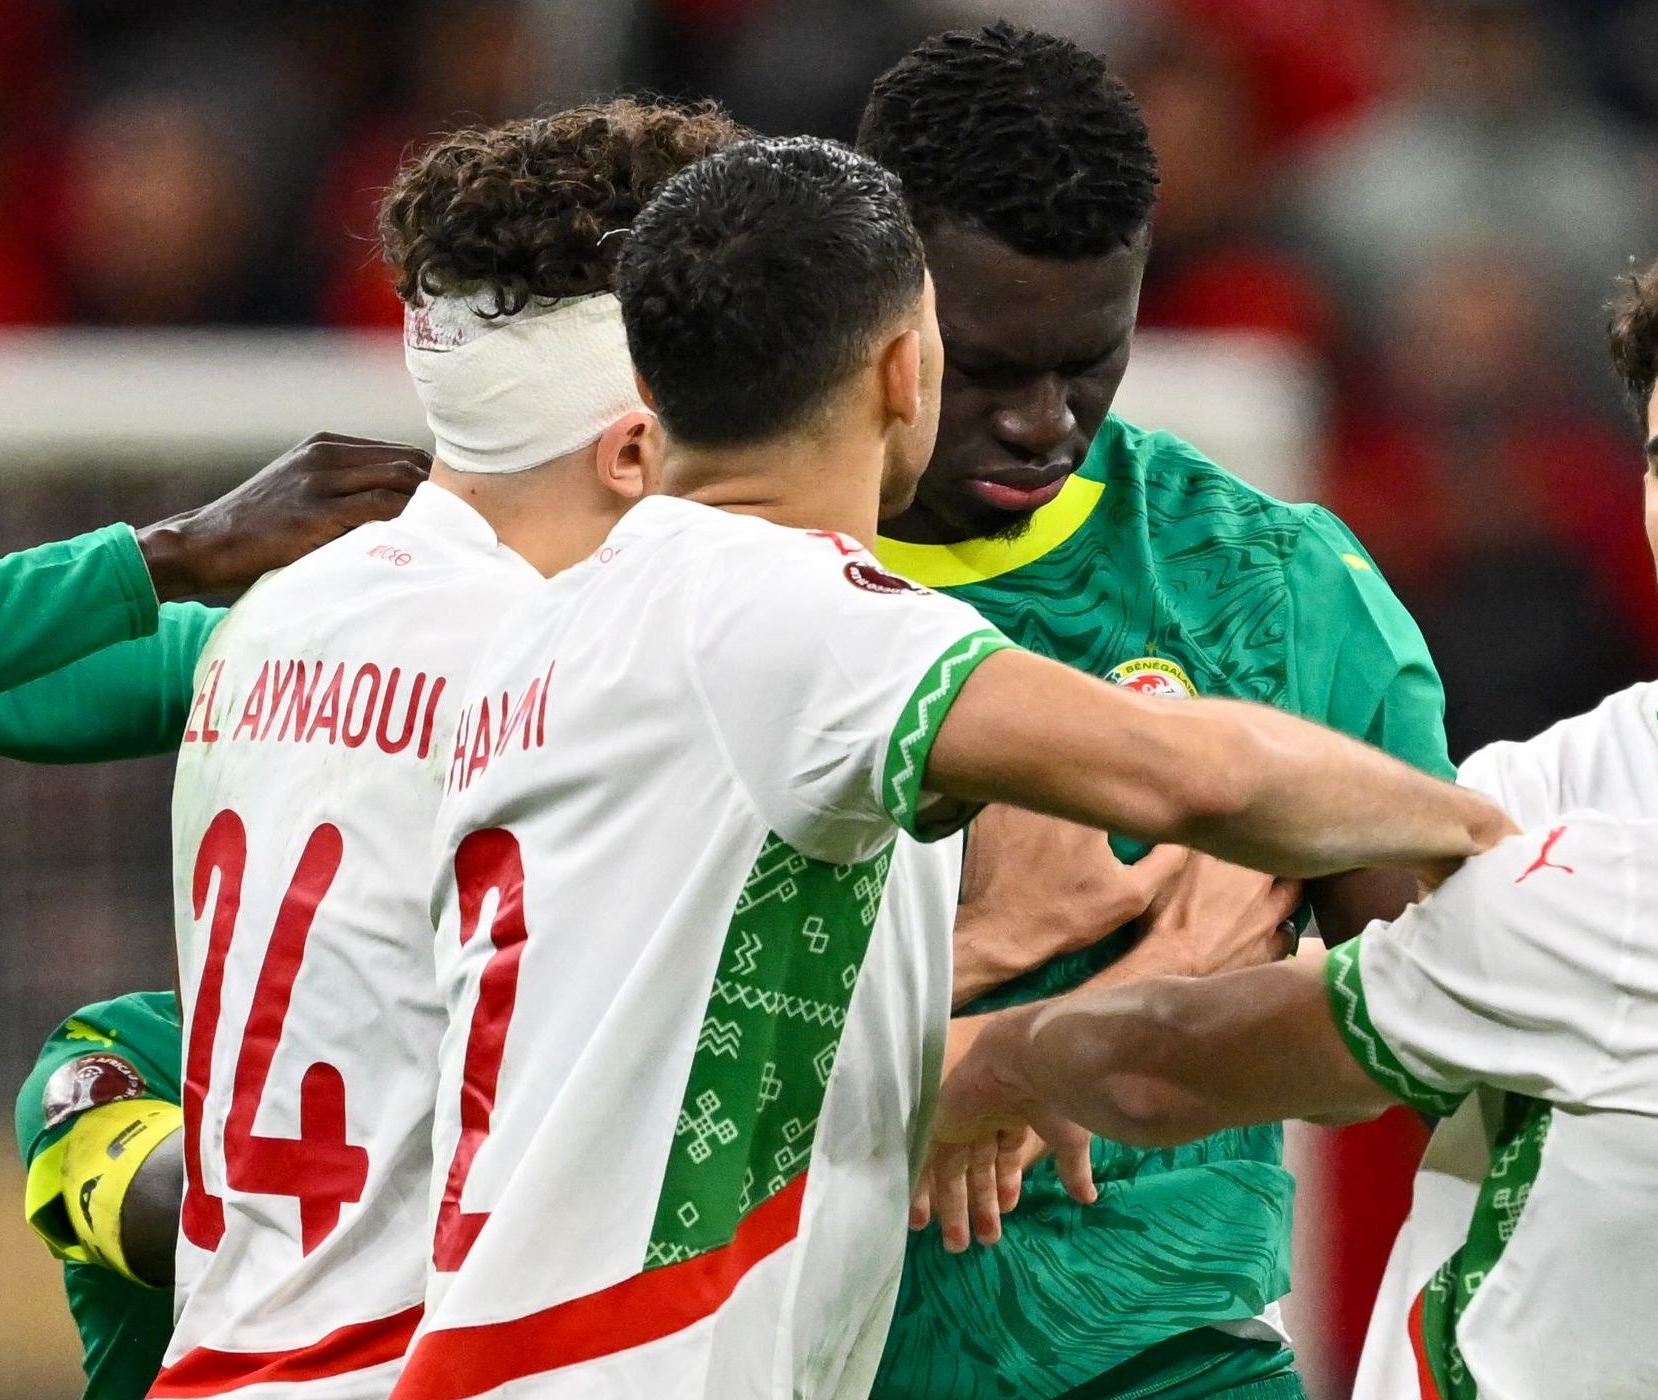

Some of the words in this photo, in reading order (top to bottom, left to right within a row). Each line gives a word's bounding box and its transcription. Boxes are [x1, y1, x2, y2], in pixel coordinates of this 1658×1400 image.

[183, 659, 225, 742] EL
[233, 659, 446, 760] AYNAOUI
[432, 827, 529, 1272] 2
